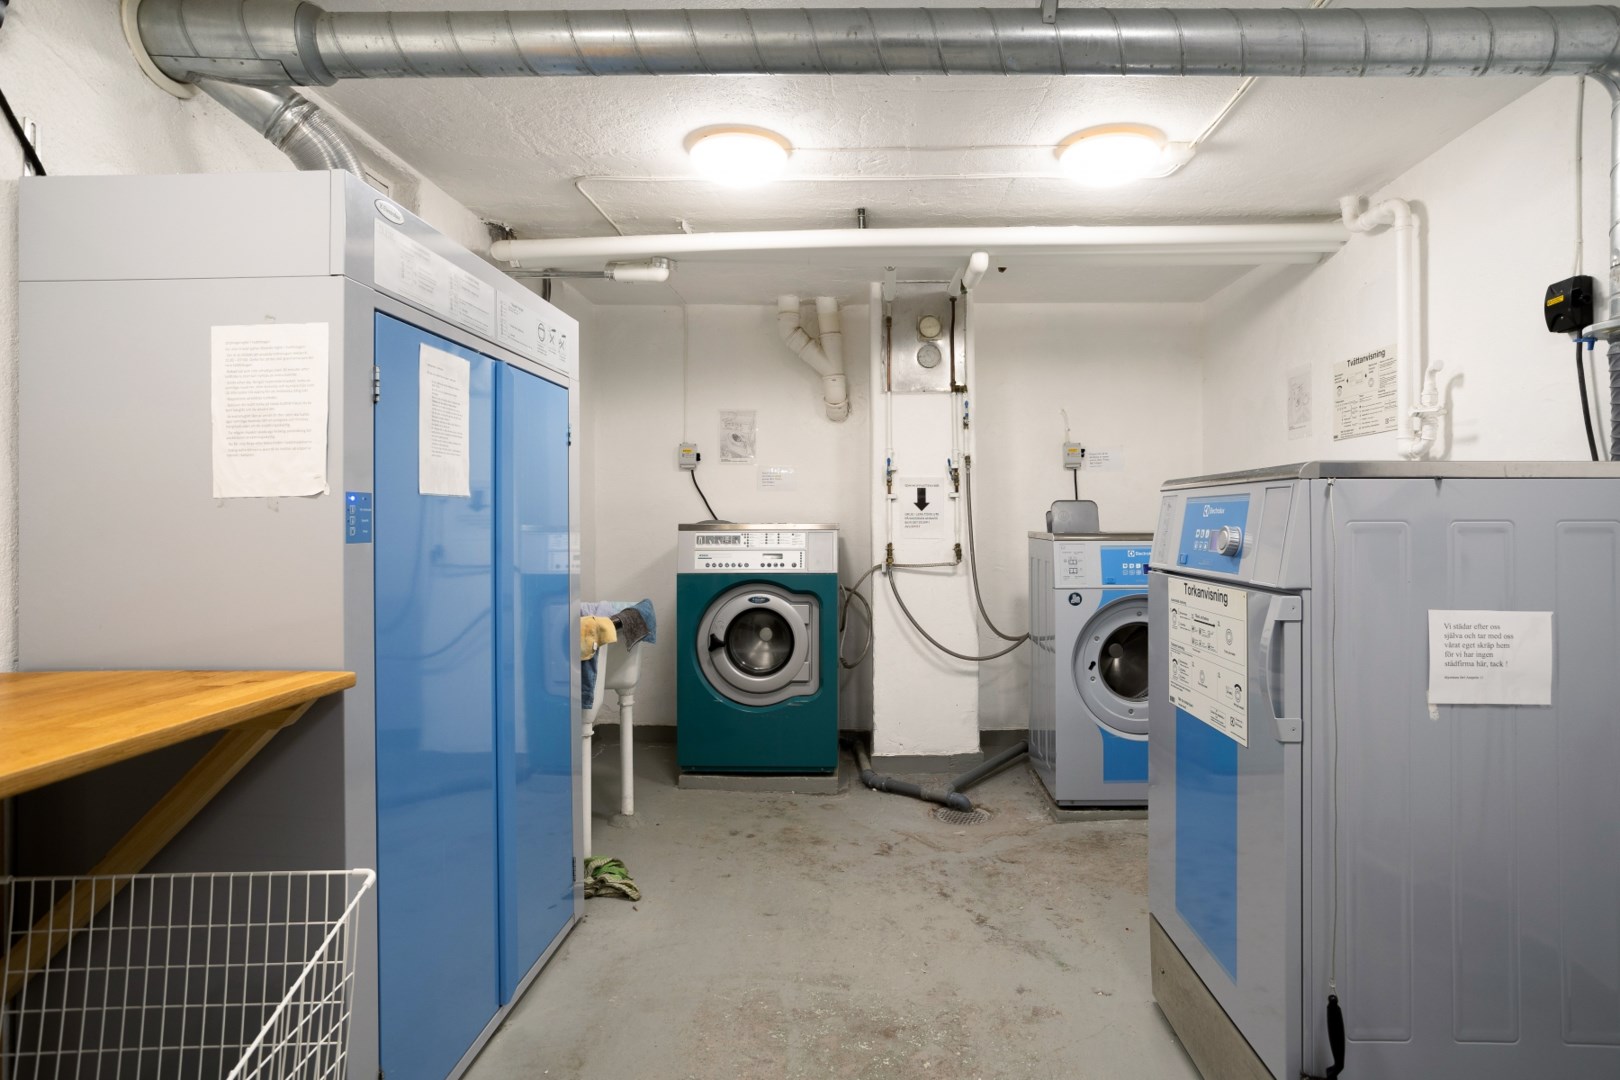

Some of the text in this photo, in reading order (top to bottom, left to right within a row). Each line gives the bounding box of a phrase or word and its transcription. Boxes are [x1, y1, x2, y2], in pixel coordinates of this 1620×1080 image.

[1347, 350, 1386, 368] Tvättanvisning
[1184, 583, 1229, 607] Torkanvisning
[1444, 622, 1452, 630] Vi
[1453, 622, 1472, 630] städar
[1474, 622, 1489, 630] efter
[1444, 632, 1463, 641] själva
[1444, 641, 1511, 650] vårat eget skräp hem
[1444, 650, 1454, 658] för
[1463, 650, 1474, 658] har
[1476, 651, 1494, 660] ingen
[1444, 659, 1475, 667] städfirma
[1476, 659, 1489, 668] här,
[1490, 660, 1504, 668] tack
